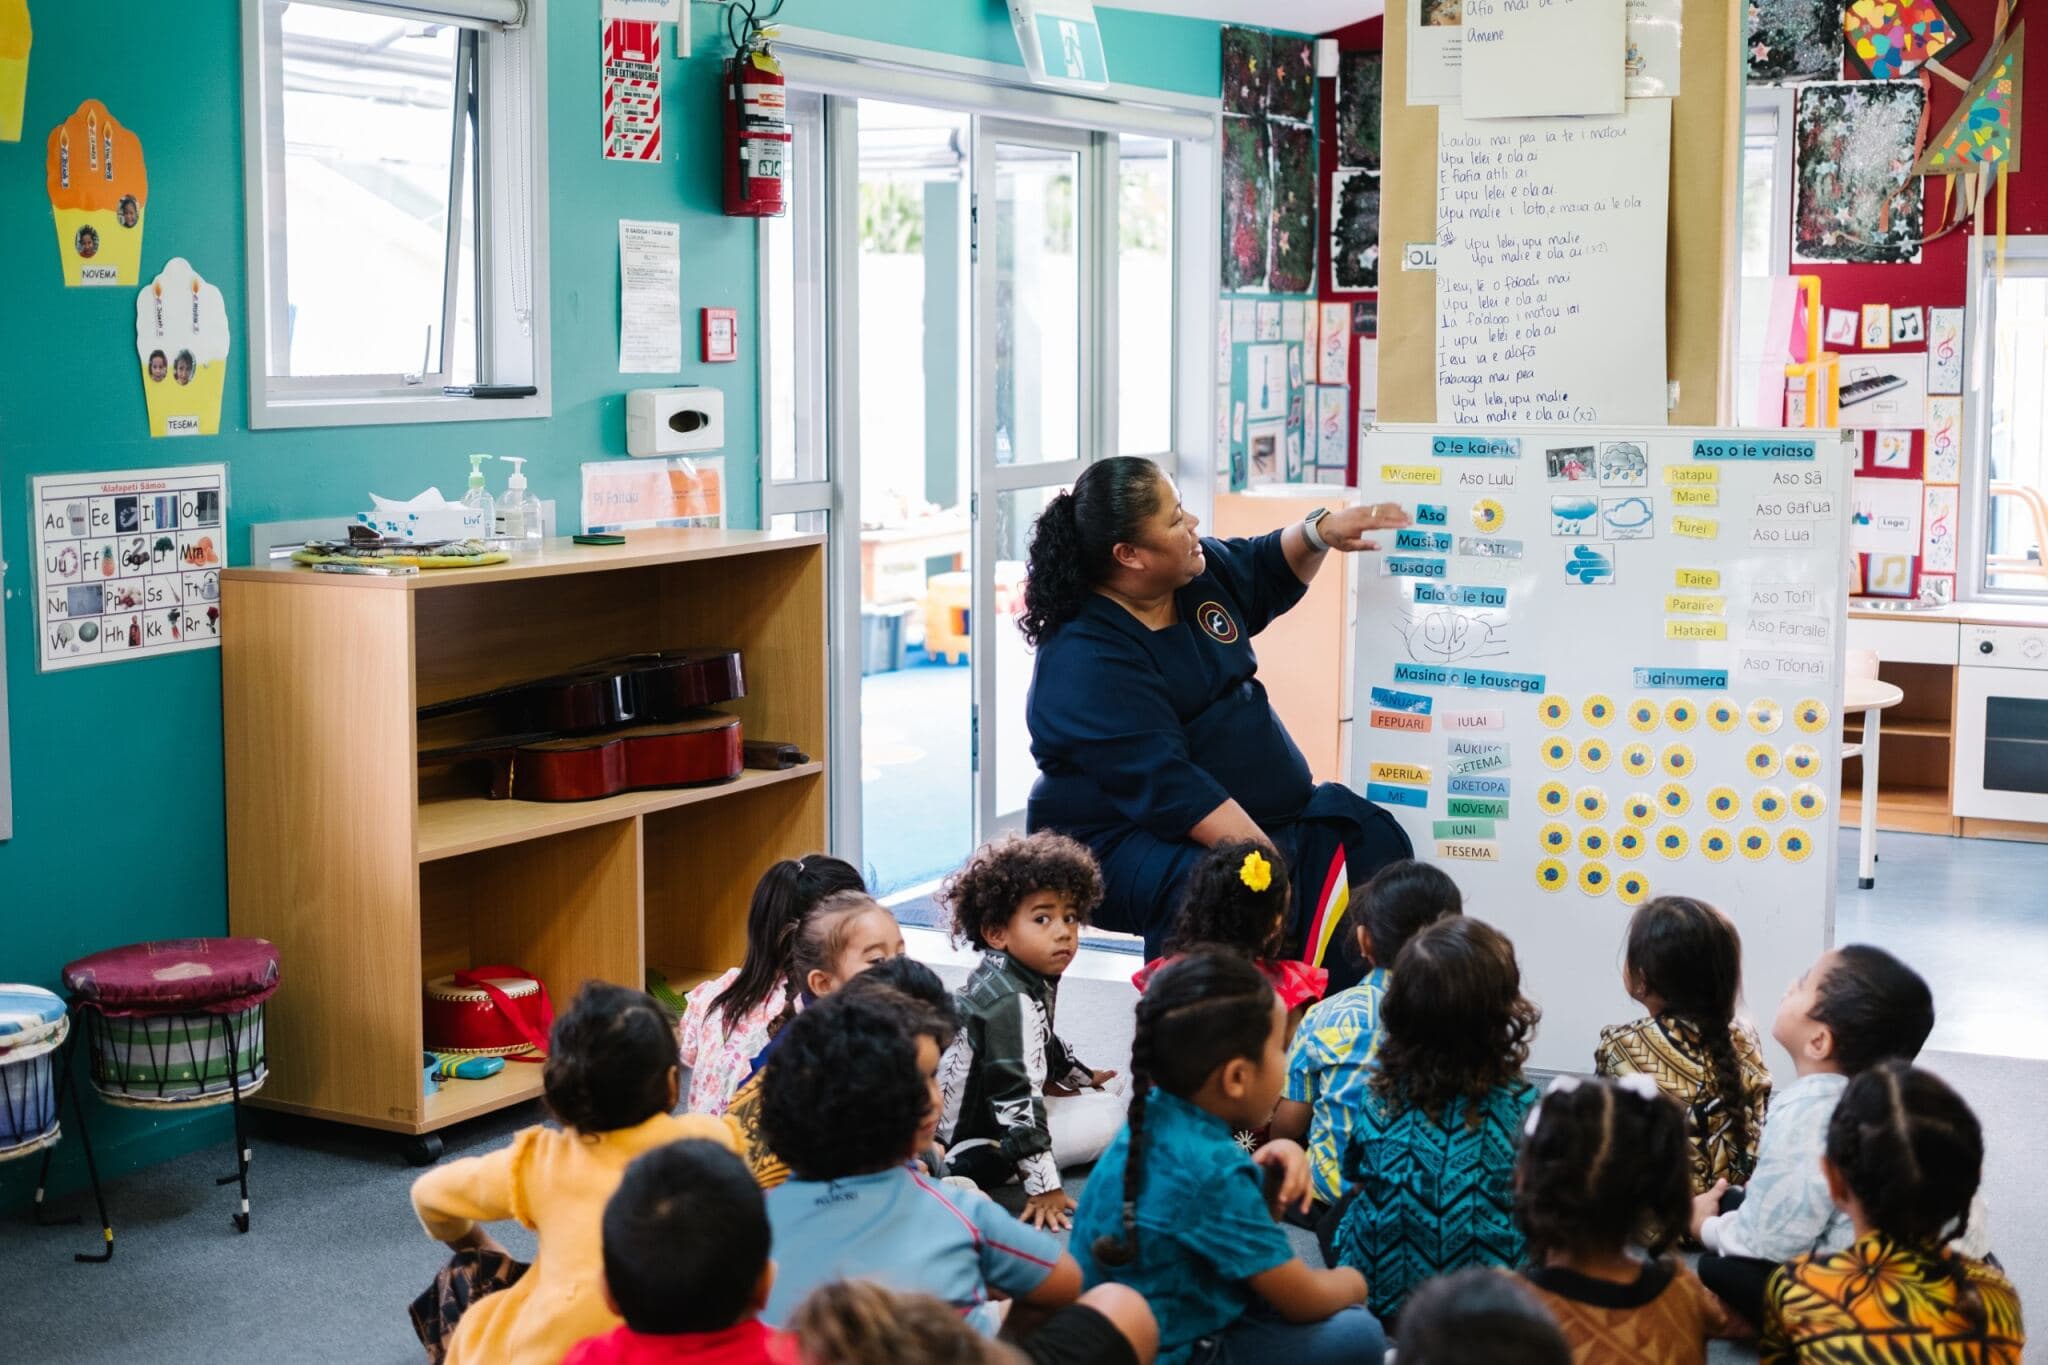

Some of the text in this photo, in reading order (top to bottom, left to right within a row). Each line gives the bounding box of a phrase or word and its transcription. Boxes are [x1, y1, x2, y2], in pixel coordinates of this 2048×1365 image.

[606, 68, 659, 81] FIRE EXTINGUISHER
[1590, 126, 1627, 139] matou
[1497, 153, 1503, 163] e
[1508, 149, 1524, 163] ola
[1511, 186, 1517, 197] e
[1547, 246, 1564, 259] ola
[82, 268, 117, 280] NOVEMA
[1516, 292, 1531, 304] ola
[1526, 324, 1541, 338] ola
[1536, 407, 1552, 420] ola
[168, 420, 198, 430] TESEMA
[1434, 441, 1463, 453] O le
[1694, 444, 1814, 458] Aso o le vaiaso
[1388, 468, 1436, 481] Wenerei
[1459, 473, 1514, 486] Aso Lulu
[1672, 469, 1713, 482] Ratapu
[1773, 473, 1799, 485] Aso
[1676, 491, 1711, 502] Mane
[1418, 509, 1445, 521] Aso
[1756, 504, 1782, 516] Aso
[45, 513, 65, 529] Aa
[92, 508, 110, 526] Ee
[142, 505, 154, 522] Ii
[464, 514, 481, 525] Livi
[1676, 521, 1707, 534] Turei
[1752, 528, 1809, 541] Aso Lua
[1397, 534, 1449, 549] Masina
[46, 556, 67, 573] Uu
[83, 552, 99, 571] Ff
[121, 550, 141, 571] Gg
[180, 544, 203, 560] Mm
[1683, 573, 1712, 585] Taite
[49, 583, 199, 614] Nn Pp Ss Tt
[1416, 587, 1504, 605] Tala o le tau
[1752, 591, 1812, 604] Aso Tofi
[1672, 599, 1714, 611] Paraire
[51, 617, 200, 650] Vv Hh Kk Rr
[1674, 625, 1716, 636] Hatarei
[1748, 619, 1826, 638] Aso Faraile
[1743, 657, 1770, 671] Aso
[1395, 668, 1539, 692] Masina o le tausaga
[1635, 671, 1725, 687] Fuainumera
[1378, 716, 1424, 730] FEPUARI
[1458, 717, 1486, 727] IULAI
[1457, 756, 1502, 774] SETEMA
[1378, 767, 1423, 780] APERILA
[1452, 780, 1505, 793] OKETOPA
[1388, 791, 1406, 800] ME
[1453, 804, 1504, 815] NOVEMA
[1452, 824, 1476, 835] IUNI
[1446, 846, 1491, 858] TESEMA
